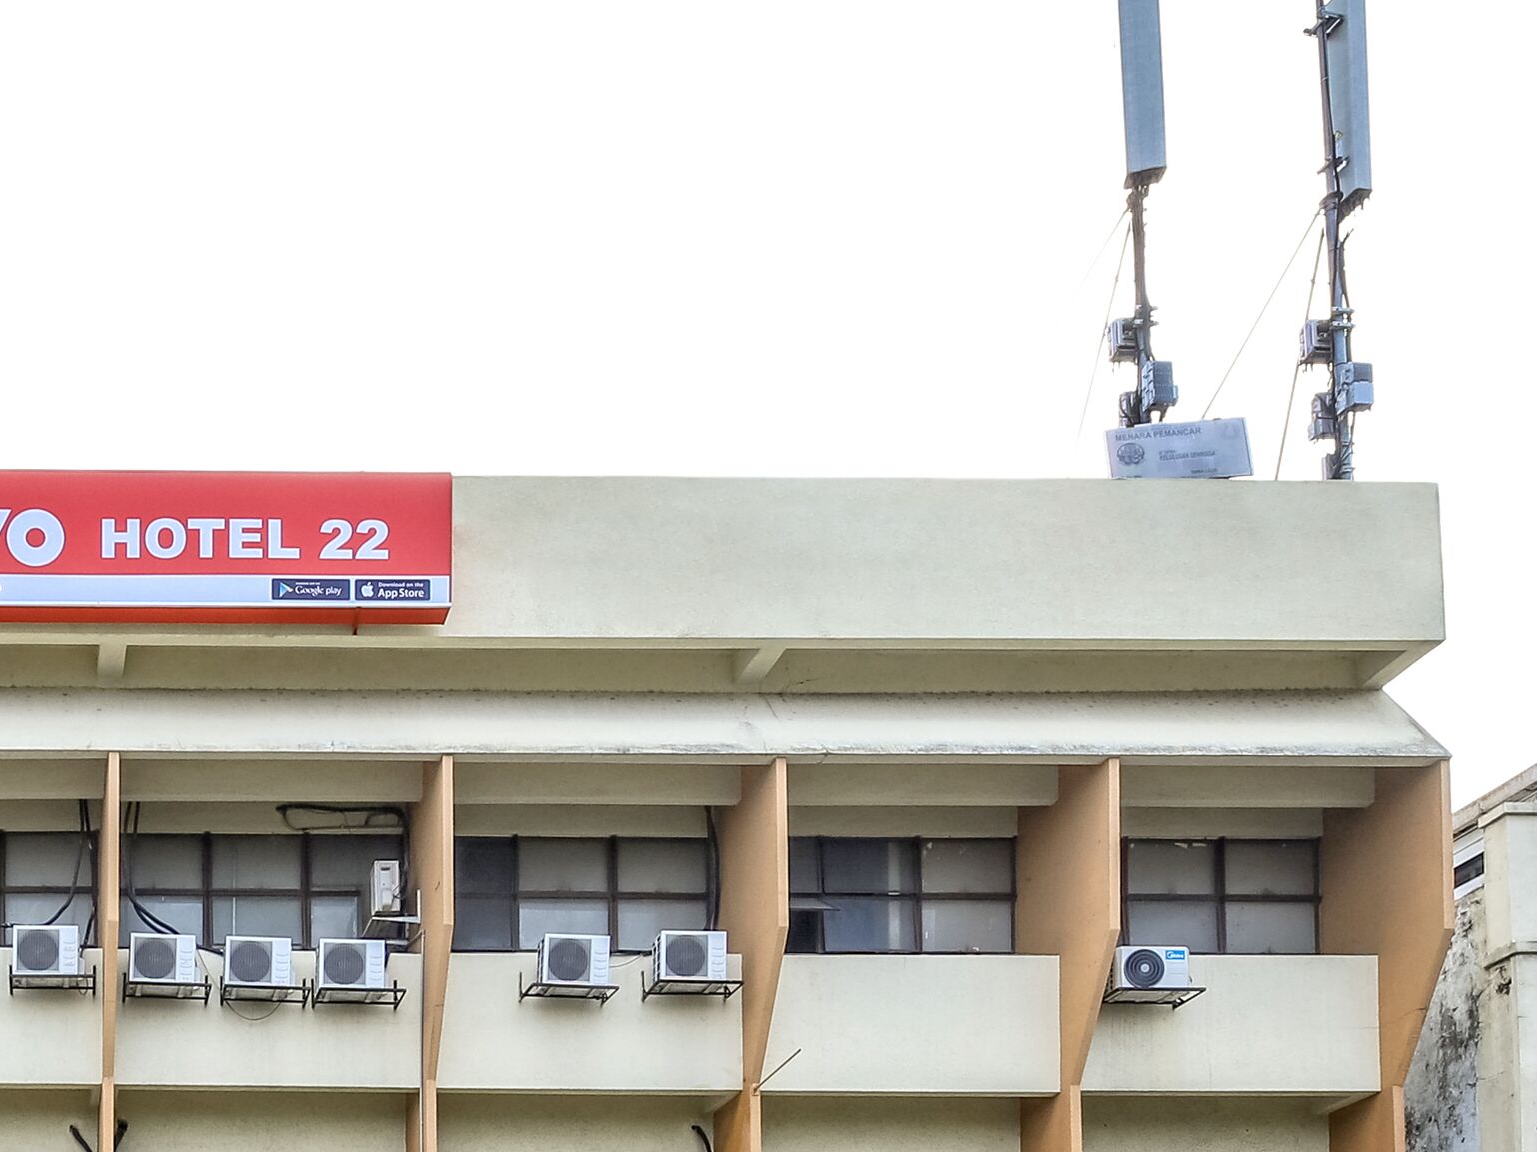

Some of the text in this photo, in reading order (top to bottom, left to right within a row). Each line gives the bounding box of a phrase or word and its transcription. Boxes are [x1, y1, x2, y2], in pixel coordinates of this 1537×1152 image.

[1115, 427, 1201, 441] MENARA PEMANCAR
[100, 518, 301, 561] HOTEL
[319, 518, 390, 561] 22
[295, 585, 342, 598] Google play
[377, 588, 424, 599] App Store
